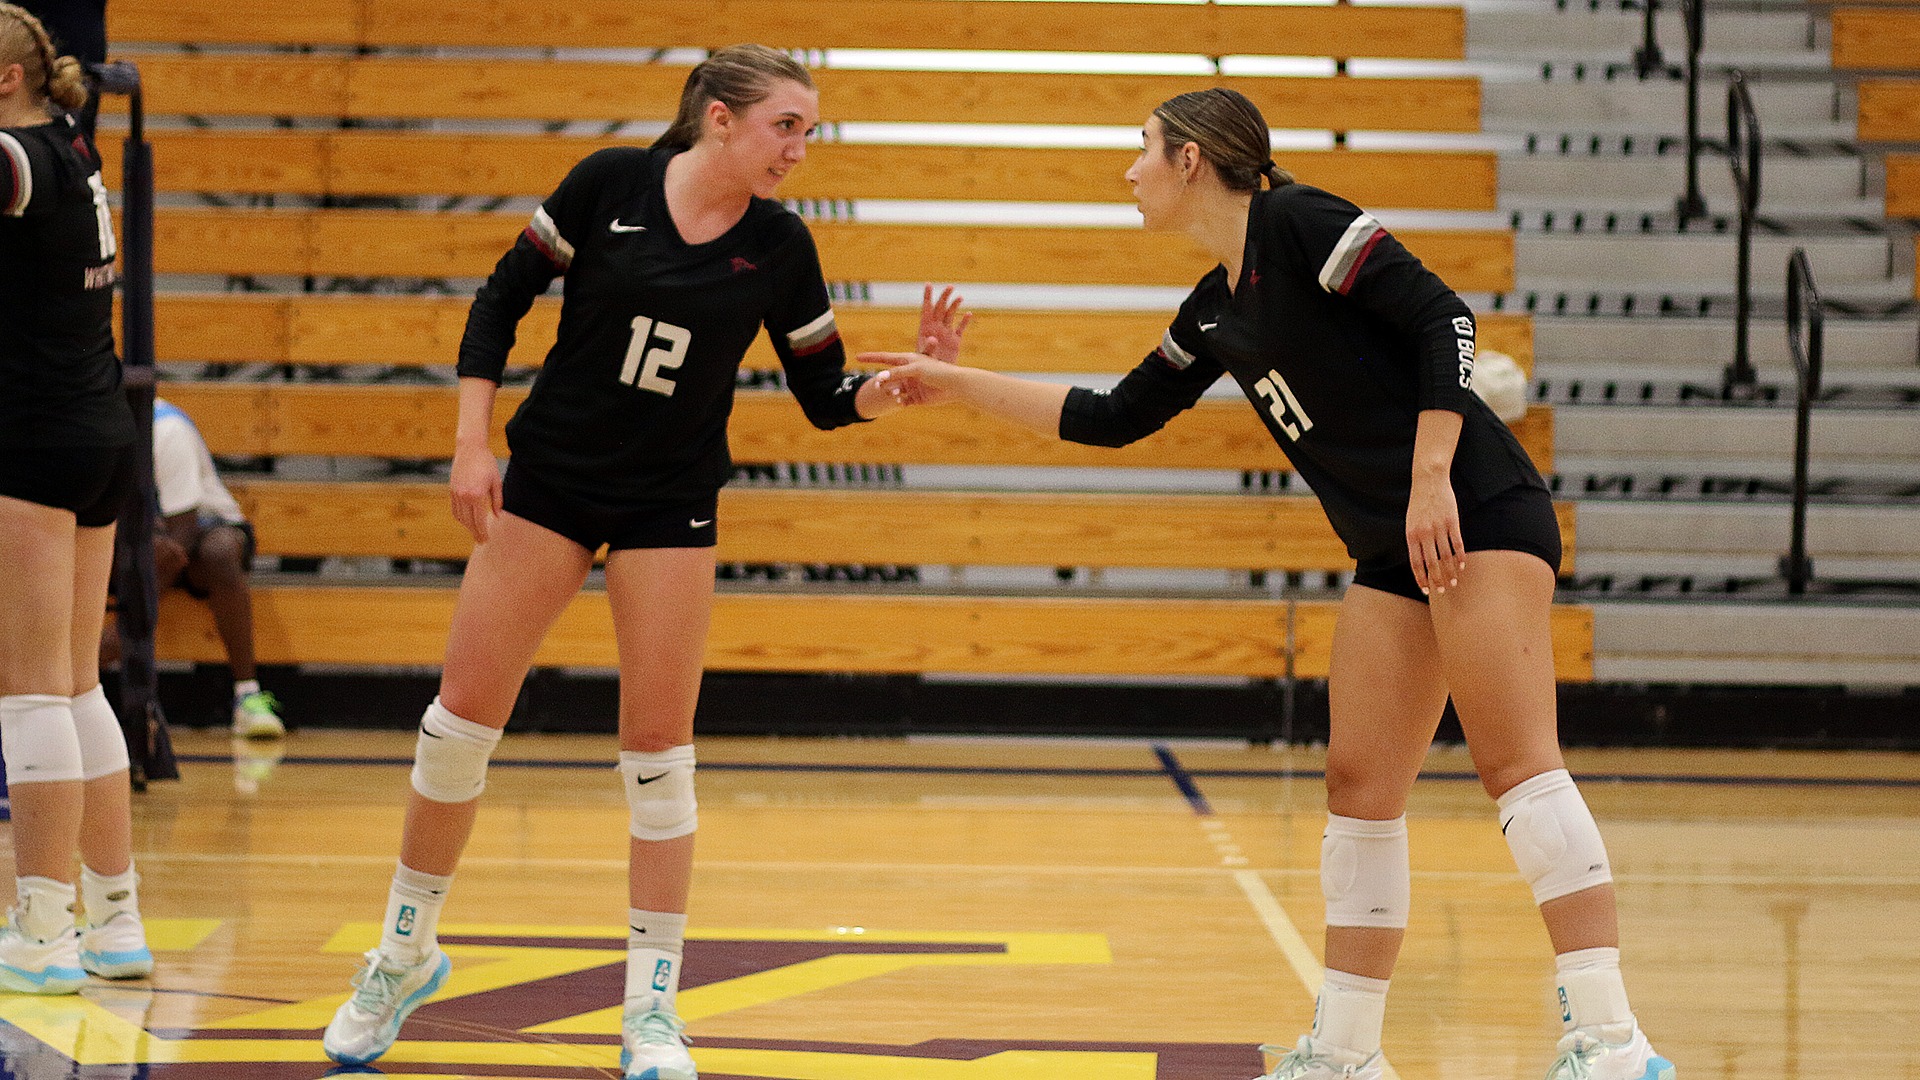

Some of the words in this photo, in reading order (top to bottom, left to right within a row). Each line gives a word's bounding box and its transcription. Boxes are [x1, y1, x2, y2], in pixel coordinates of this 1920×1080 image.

[620, 315, 692, 397] 12
[1457, 338, 1475, 391] BUCS
[1254, 368, 1314, 442] 21
